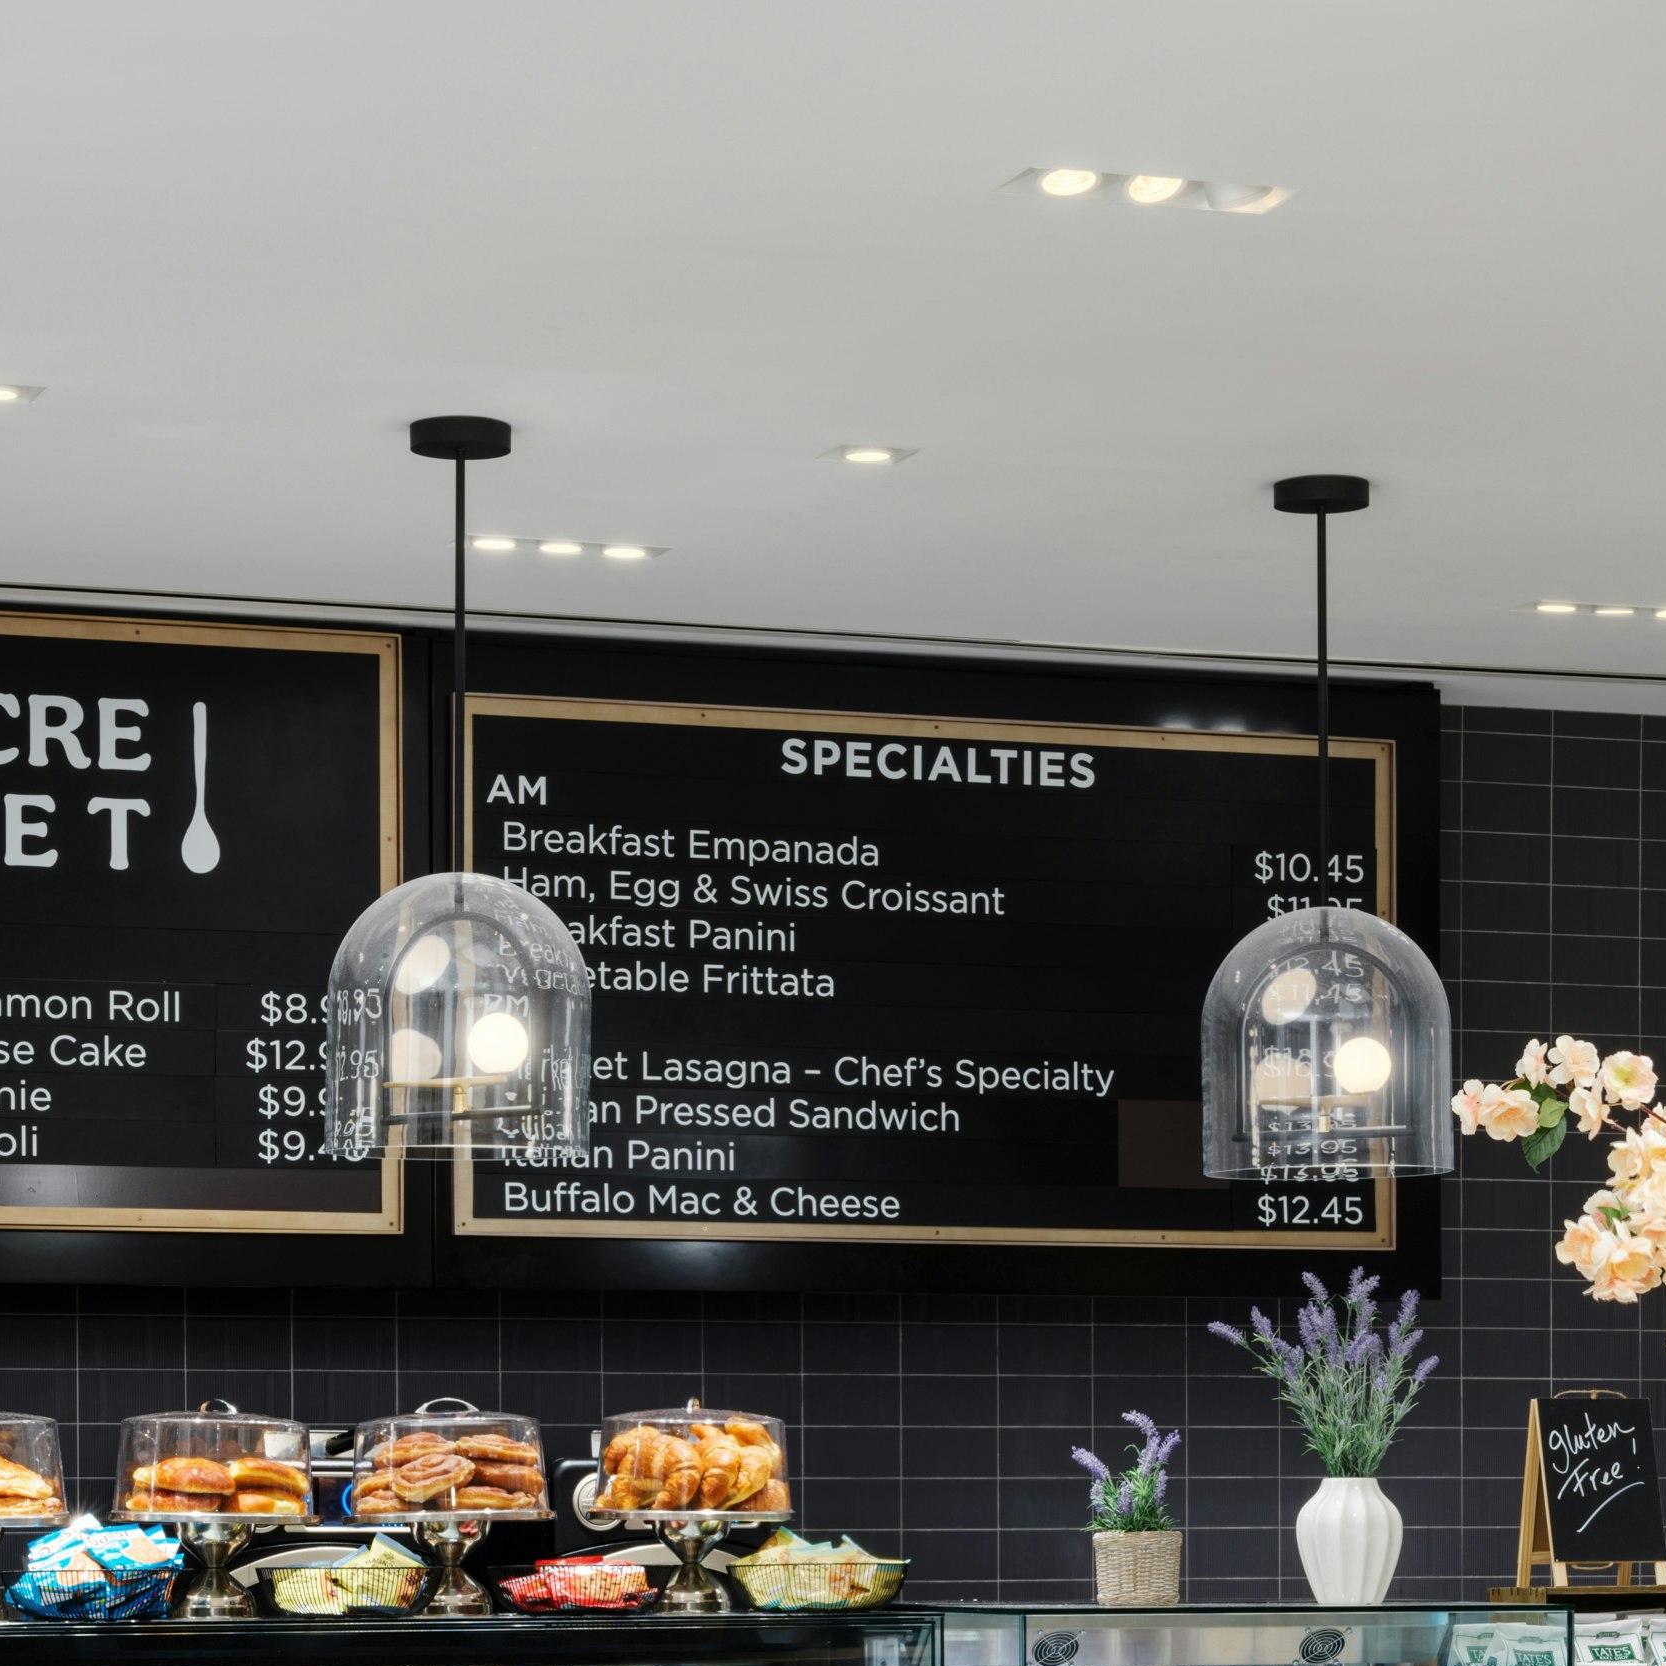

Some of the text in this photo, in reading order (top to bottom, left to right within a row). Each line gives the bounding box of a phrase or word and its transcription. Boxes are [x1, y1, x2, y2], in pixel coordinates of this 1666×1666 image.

[780, 737, 1097, 789] SPECIALTIES
[486, 774, 547, 806] AM
[503, 821, 879, 867] Breakfast Empanada
[1254, 850, 1364, 884] $10.45
[503, 866, 1005, 915] Ham, Egg & Swiss Croissant
[689, 919, 795, 952] Panini
[703, 964, 834, 997] Frittata
[109, 990, 180, 1023] Roll
[49, 1034, 147, 1068] Cake
[642, 1051, 1114, 1097] Lasagna Chef's Specialty
[636, 1094, 960, 1132] Pressed Sandwich
[628, 1139, 735, 1172] Panini
[504, 1181, 900, 1219] Buffalo Mac & Cheese
[1257, 1193, 1363, 1227] $12.45
